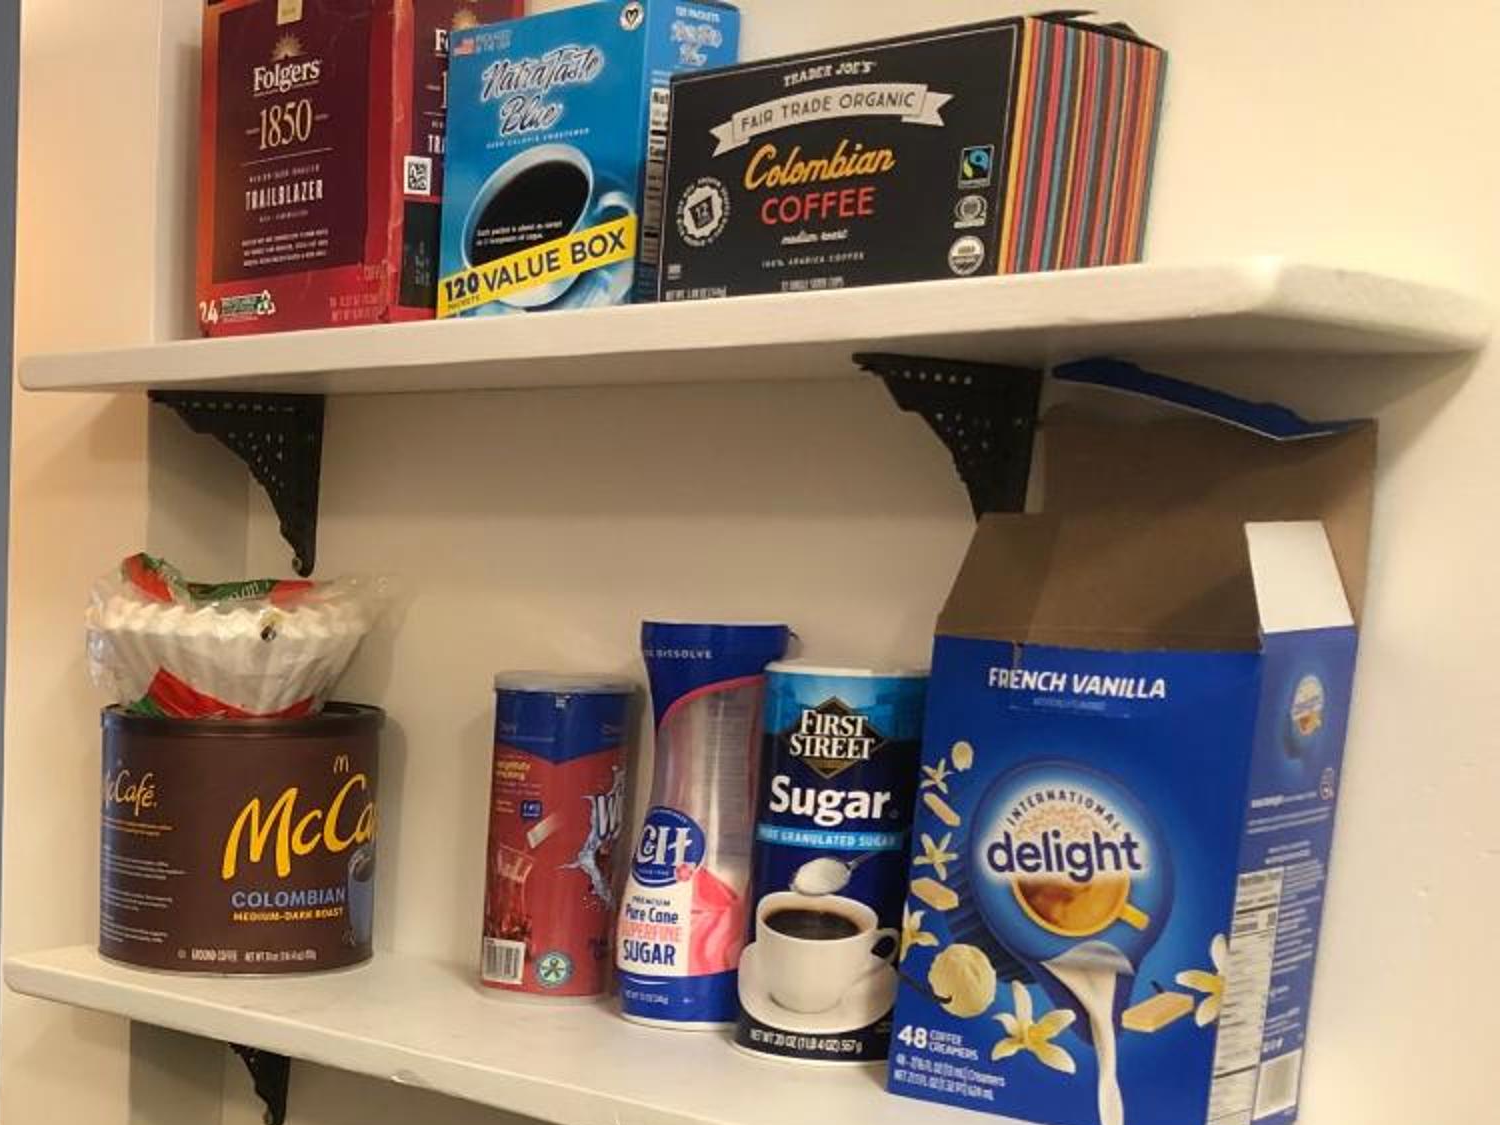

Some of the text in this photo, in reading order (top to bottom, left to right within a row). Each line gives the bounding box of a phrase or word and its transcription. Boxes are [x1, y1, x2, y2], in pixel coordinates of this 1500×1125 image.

[252, 58, 322, 93] Folgers
[784, 61, 876, 87] TRADER JOE'S
[259, 99, 313, 150] 1850
[500, 95, 564, 136] Blue
[741, 91, 916, 132] FAIR TRADE ORGANIC
[744, 139, 896, 190] Colombian
[761, 187, 876, 225] COFFEE
[445, 227, 626, 302] 120 VALUE BOX
[988, 667, 1167, 699] FRENCH VANILLA
[800, 709, 869, 738] FIRST
[788, 733, 875, 760] STREET
[769, 775, 891, 827] Sugar
[1006, 788, 1122, 832] INTERNATIONAL
[987, 829, 1143, 884] delight
[231, 887, 346, 908] COLOMBIAN
[232, 906, 344, 922] MEDIUM-DARK ROAST
[626, 903, 679, 925] Pure Cane
[623, 938, 676, 966] SUGAR
[897, 1024, 927, 1049] 48
